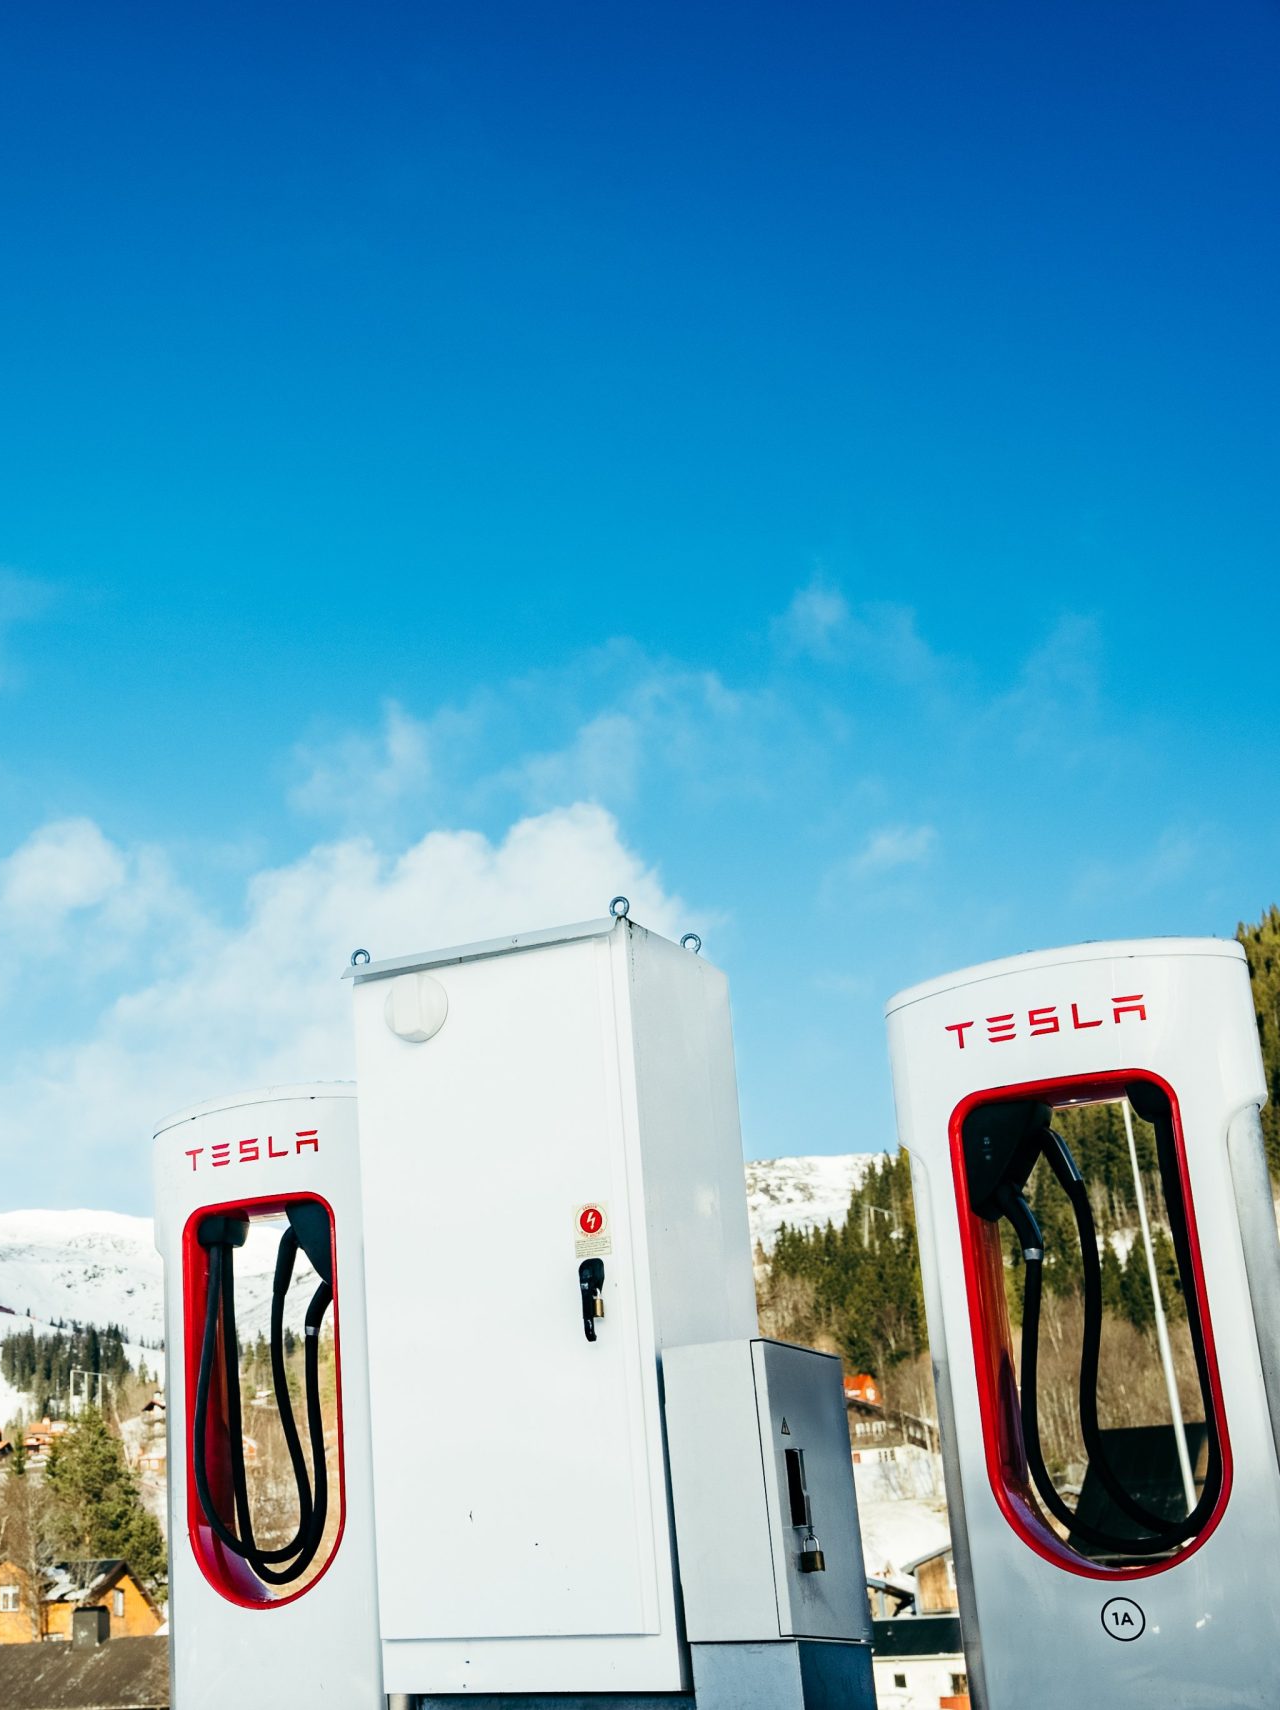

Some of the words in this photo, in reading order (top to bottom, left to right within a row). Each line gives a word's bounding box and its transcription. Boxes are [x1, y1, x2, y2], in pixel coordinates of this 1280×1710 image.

[944, 994, 1147, 1049] TESLA
[185, 1130, 319, 1171] TESLA
[1111, 1611, 1135, 1626] 1A
